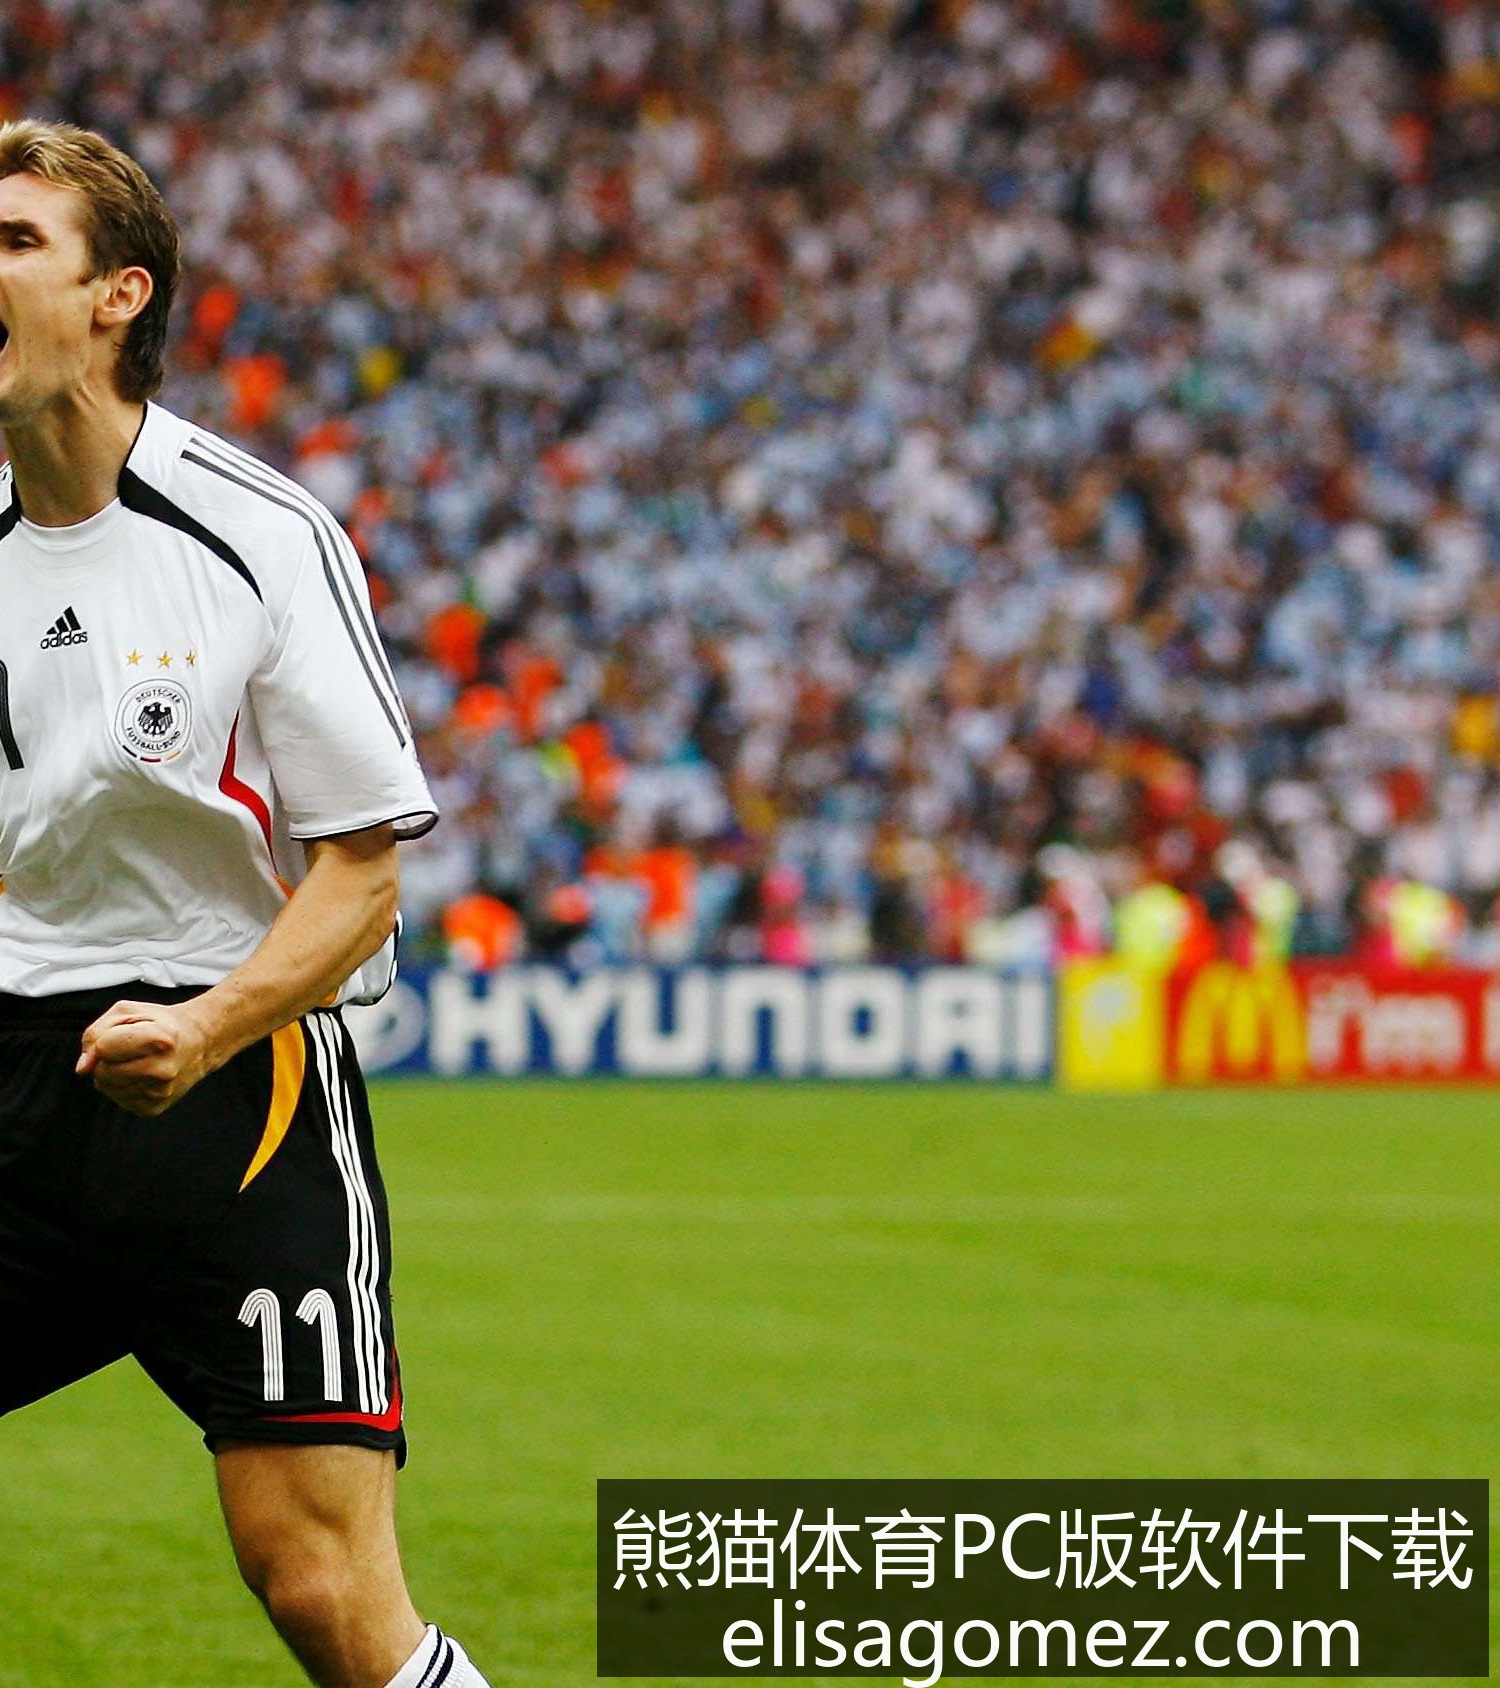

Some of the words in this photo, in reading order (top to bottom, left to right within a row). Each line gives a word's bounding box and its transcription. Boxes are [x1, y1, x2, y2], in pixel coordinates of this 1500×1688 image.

[40, 629, 88, 650] adidas
[428, 966, 1048, 1079] HYUNDAI
[237, 1288, 343, 1402] 11
